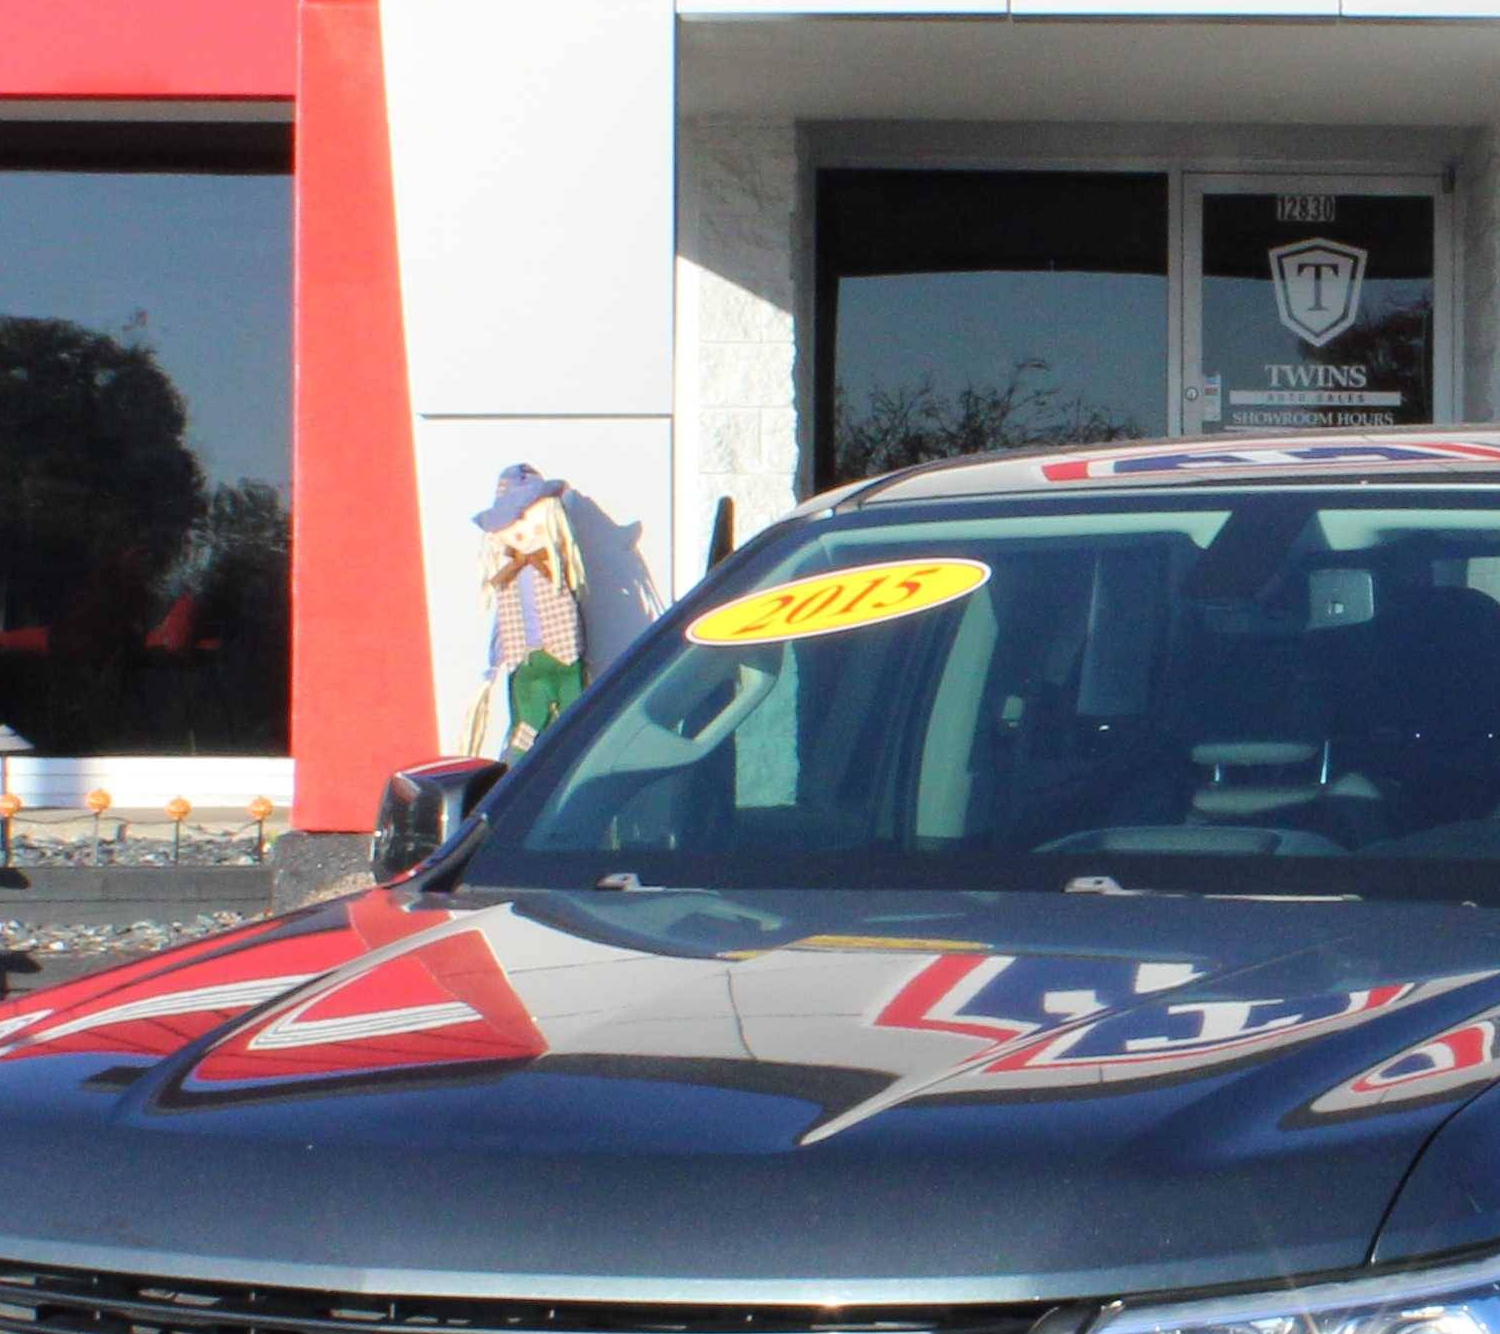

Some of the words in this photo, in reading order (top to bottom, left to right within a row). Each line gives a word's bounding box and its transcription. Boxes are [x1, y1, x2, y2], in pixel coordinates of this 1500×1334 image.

[1278, 195, 1335, 220] 12830
[1297, 263, 1340, 312] T
[1264, 364, 1367, 388] TWINS
[1232, 411, 1333, 426] SHOWROOM
[1336, 411, 1394, 426] HOURS
[731, 567, 941, 635] 2015
